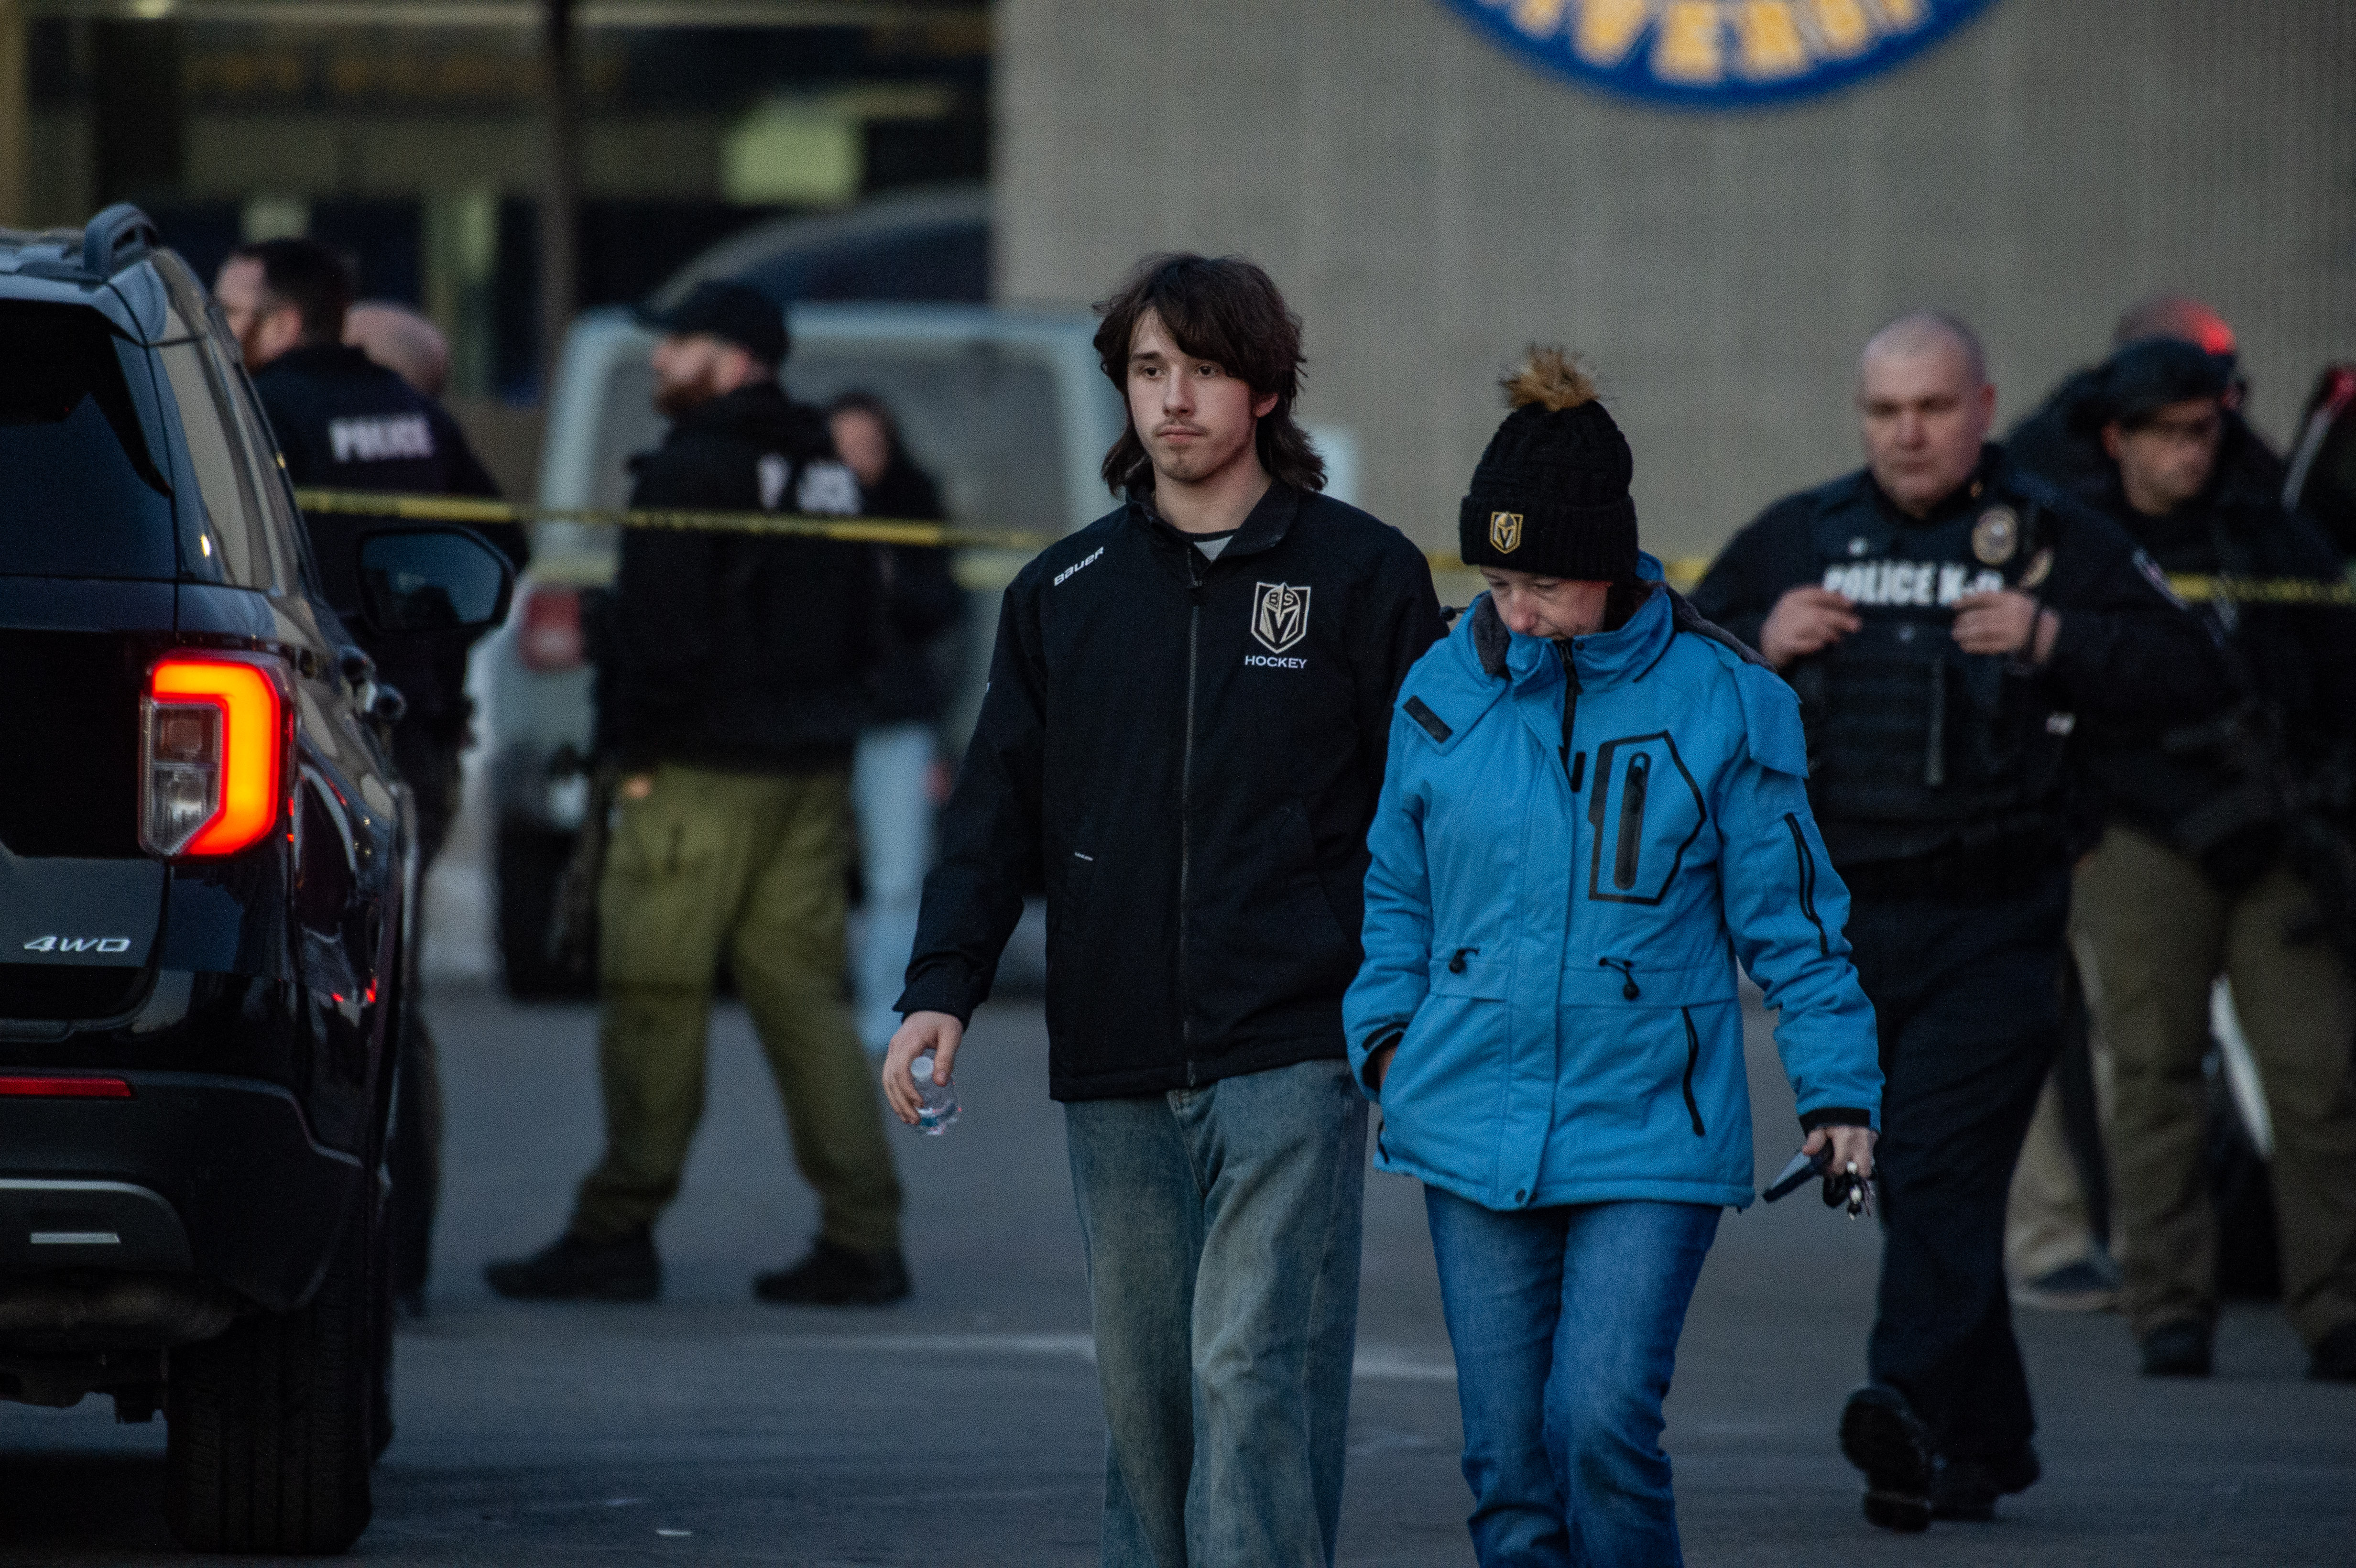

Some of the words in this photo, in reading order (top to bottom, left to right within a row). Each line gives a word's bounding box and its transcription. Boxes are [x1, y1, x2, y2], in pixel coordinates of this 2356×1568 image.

[329, 415, 433, 463] POLICE
[1054, 546, 1104, 587] BAUER
[1822, 560, 1935, 604] POLICE
[1244, 655, 1308, 669] HOCKEY
[23, 935, 131, 952] 4WD
